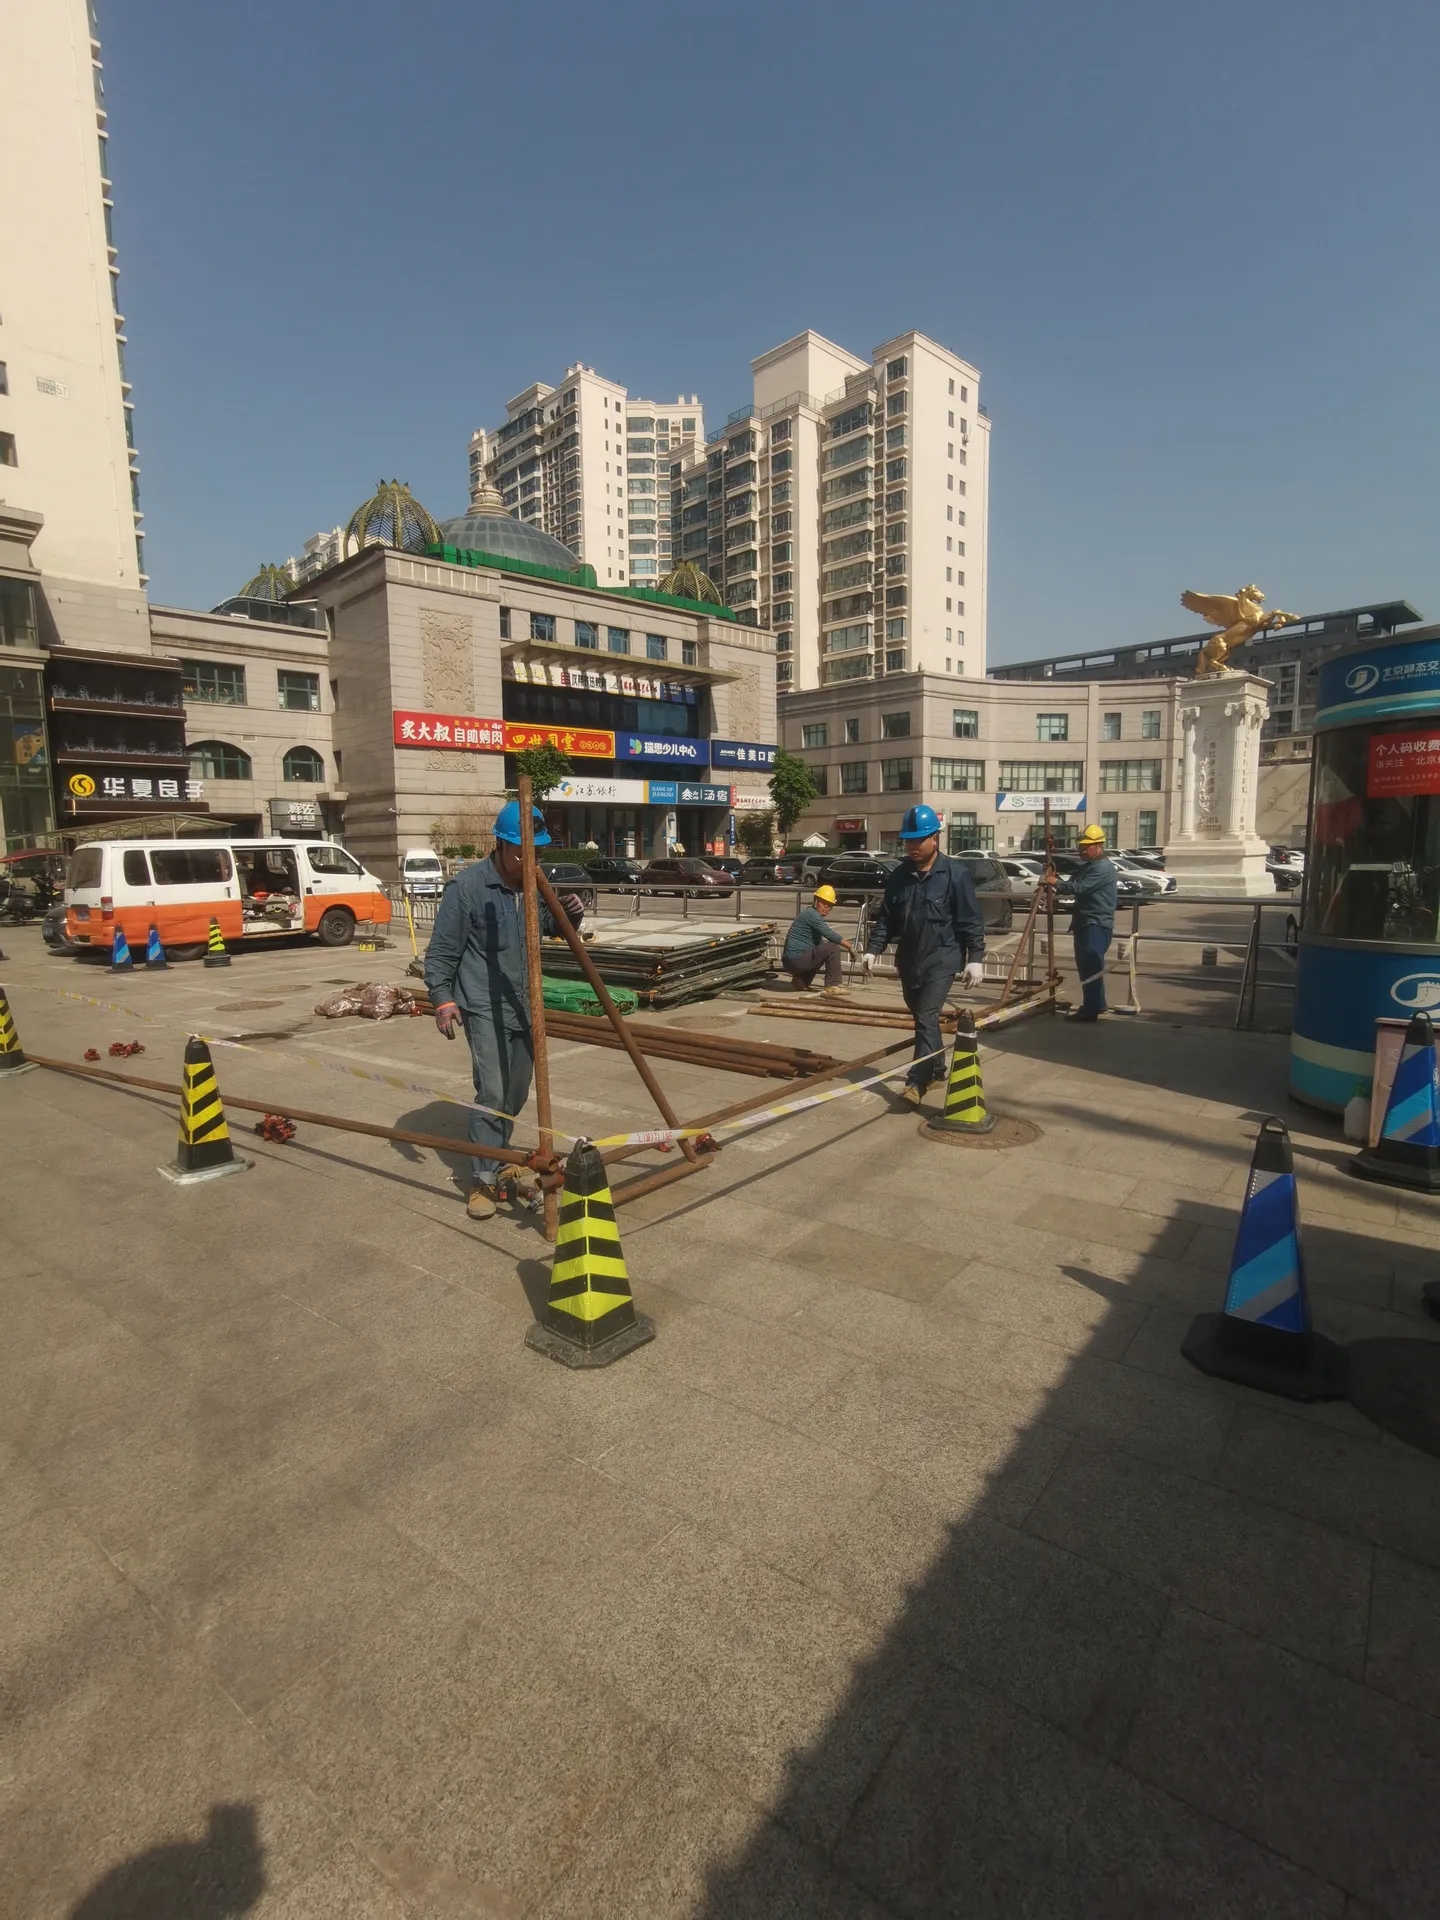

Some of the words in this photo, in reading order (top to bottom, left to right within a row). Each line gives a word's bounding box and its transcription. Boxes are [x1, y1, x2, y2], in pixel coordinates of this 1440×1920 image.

[400, 719, 452, 743] 炙大叔
[454, 727, 503, 746] 自助烤肉
[644, 741, 697, 758] 瑞思少儿中心
[736, 747, 776, 763] 佳美口腔
[1376, 739, 1440, 756] 个人码收费
[103, 777, 204, 798] 华夏良子
